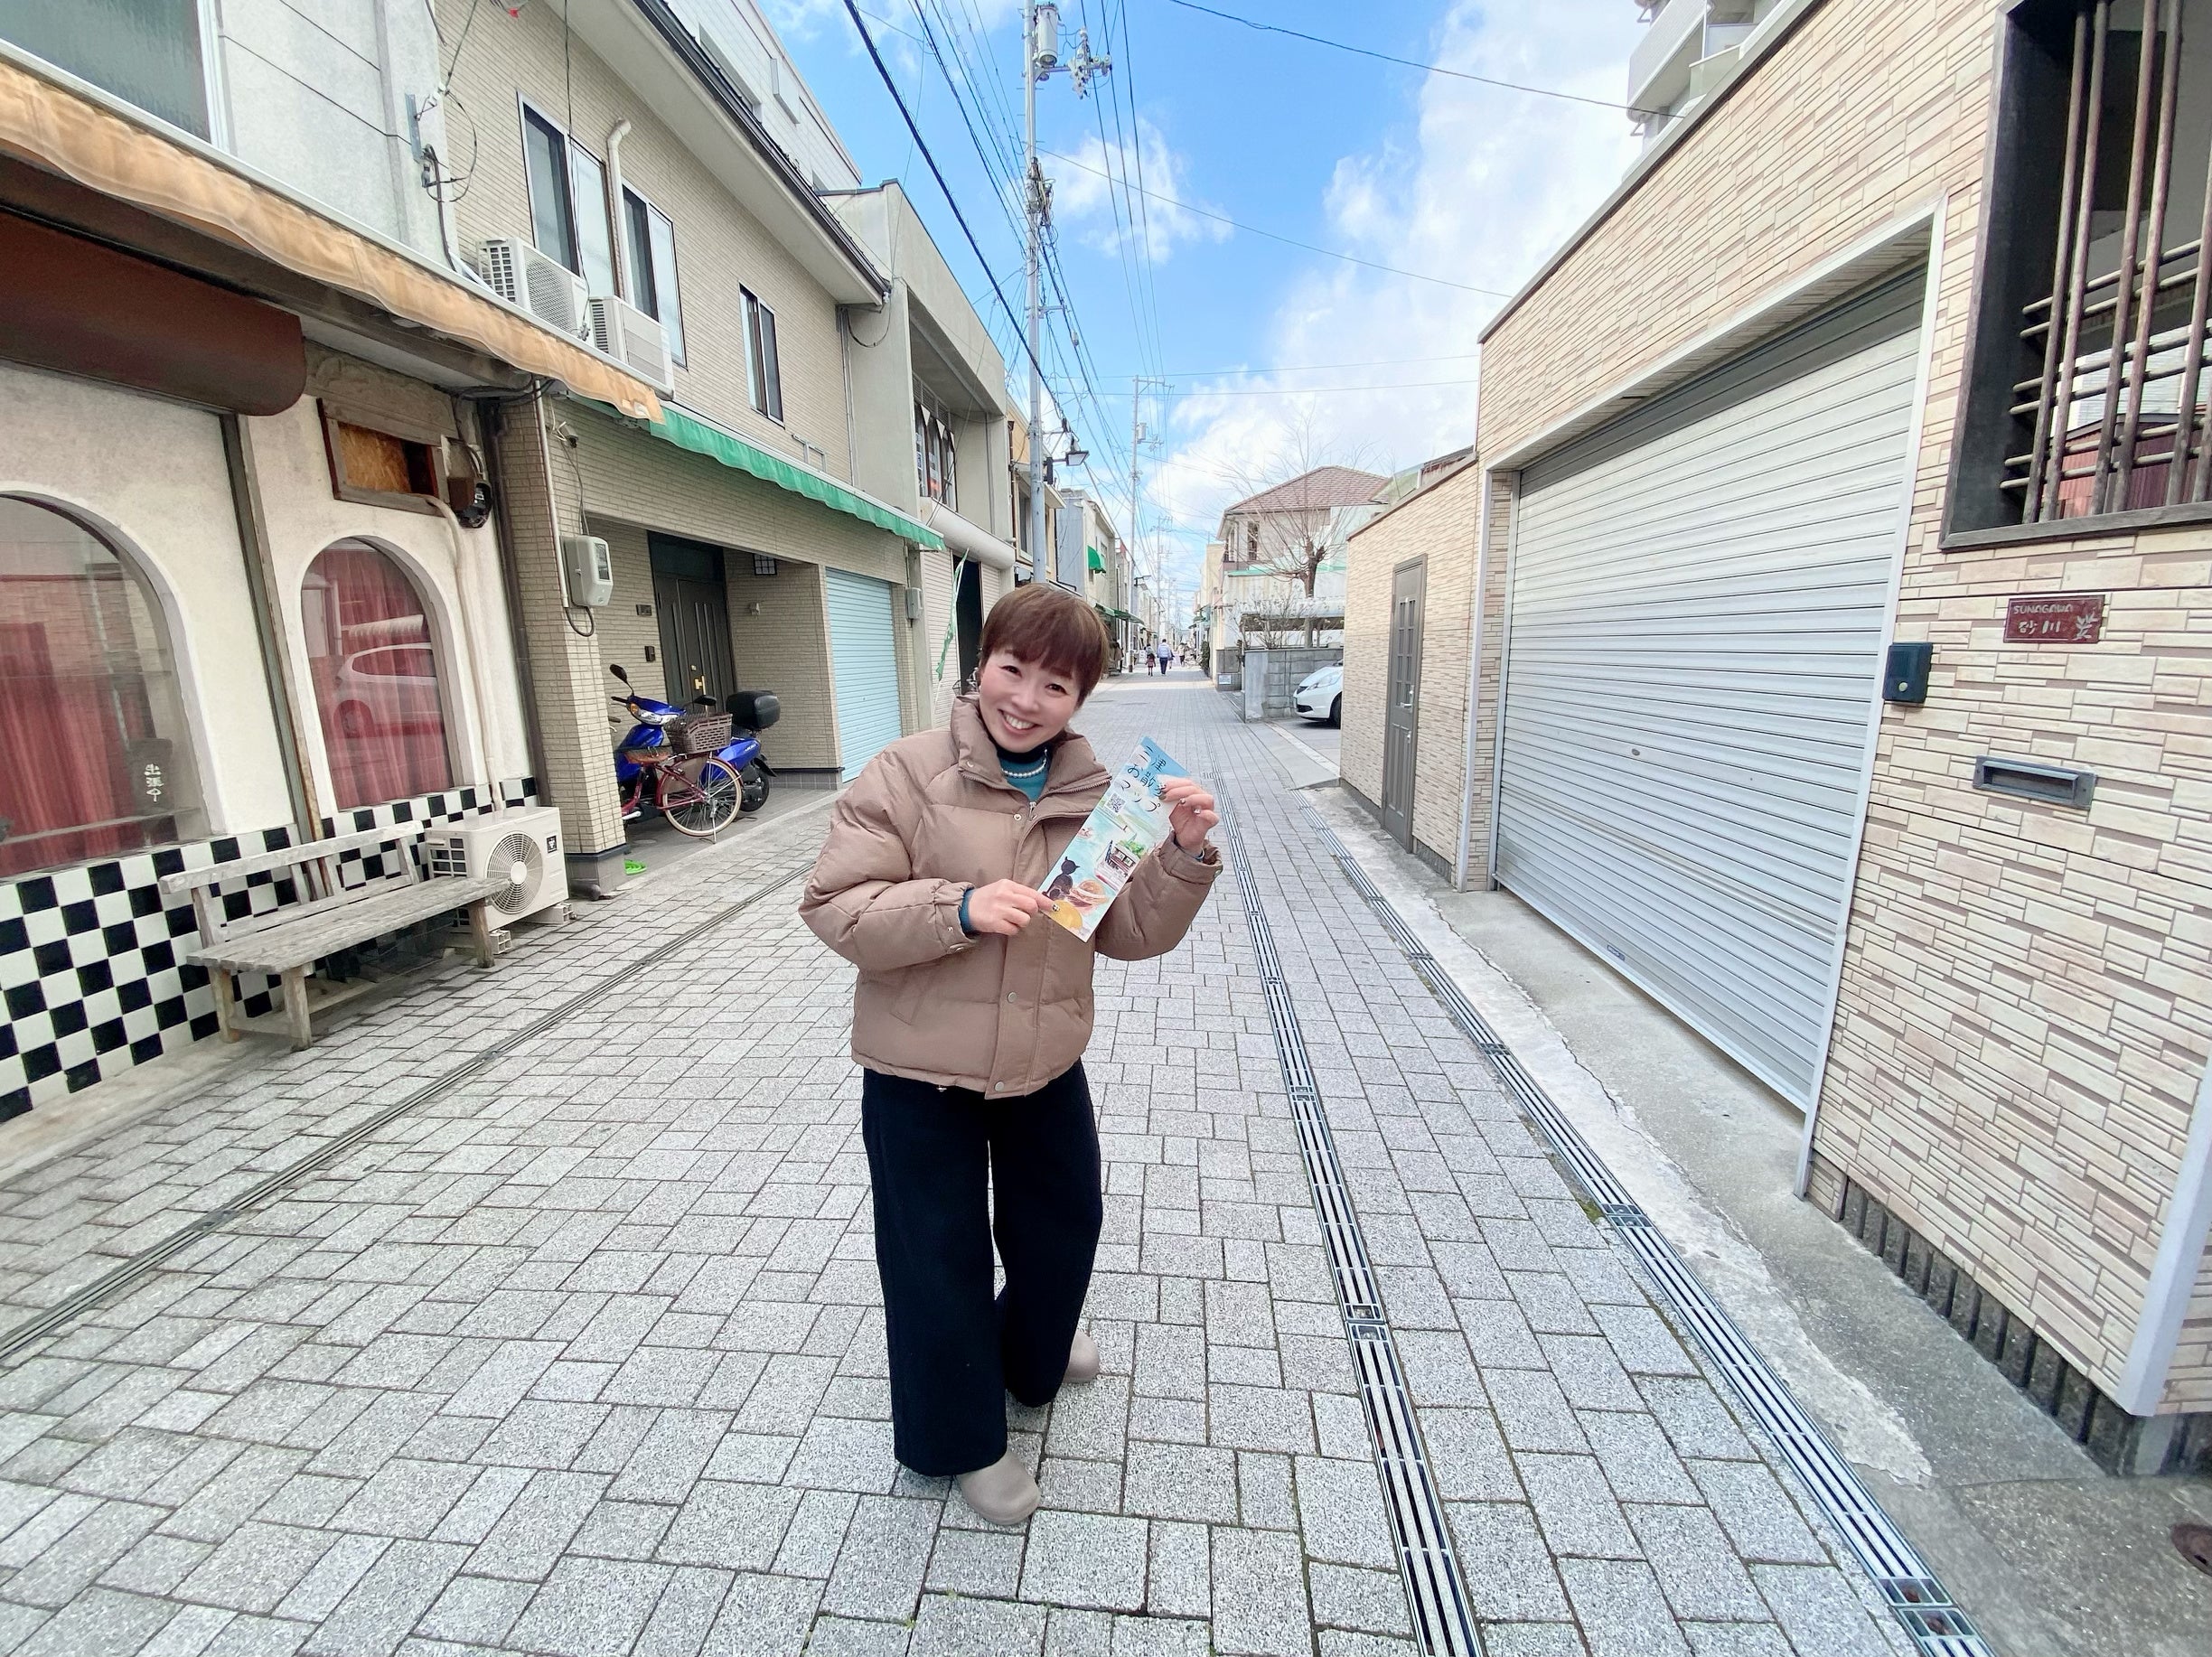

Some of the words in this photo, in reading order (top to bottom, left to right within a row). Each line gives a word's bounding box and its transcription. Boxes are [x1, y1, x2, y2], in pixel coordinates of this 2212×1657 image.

[2012, 604, 2074, 614] SUNAGAWA
[2018, 620, 2063, 635] 砂川
[1139, 745, 1167, 772] 三津
[144, 763, 164, 802] 出張中
[1120, 780, 1161, 812] マップ
